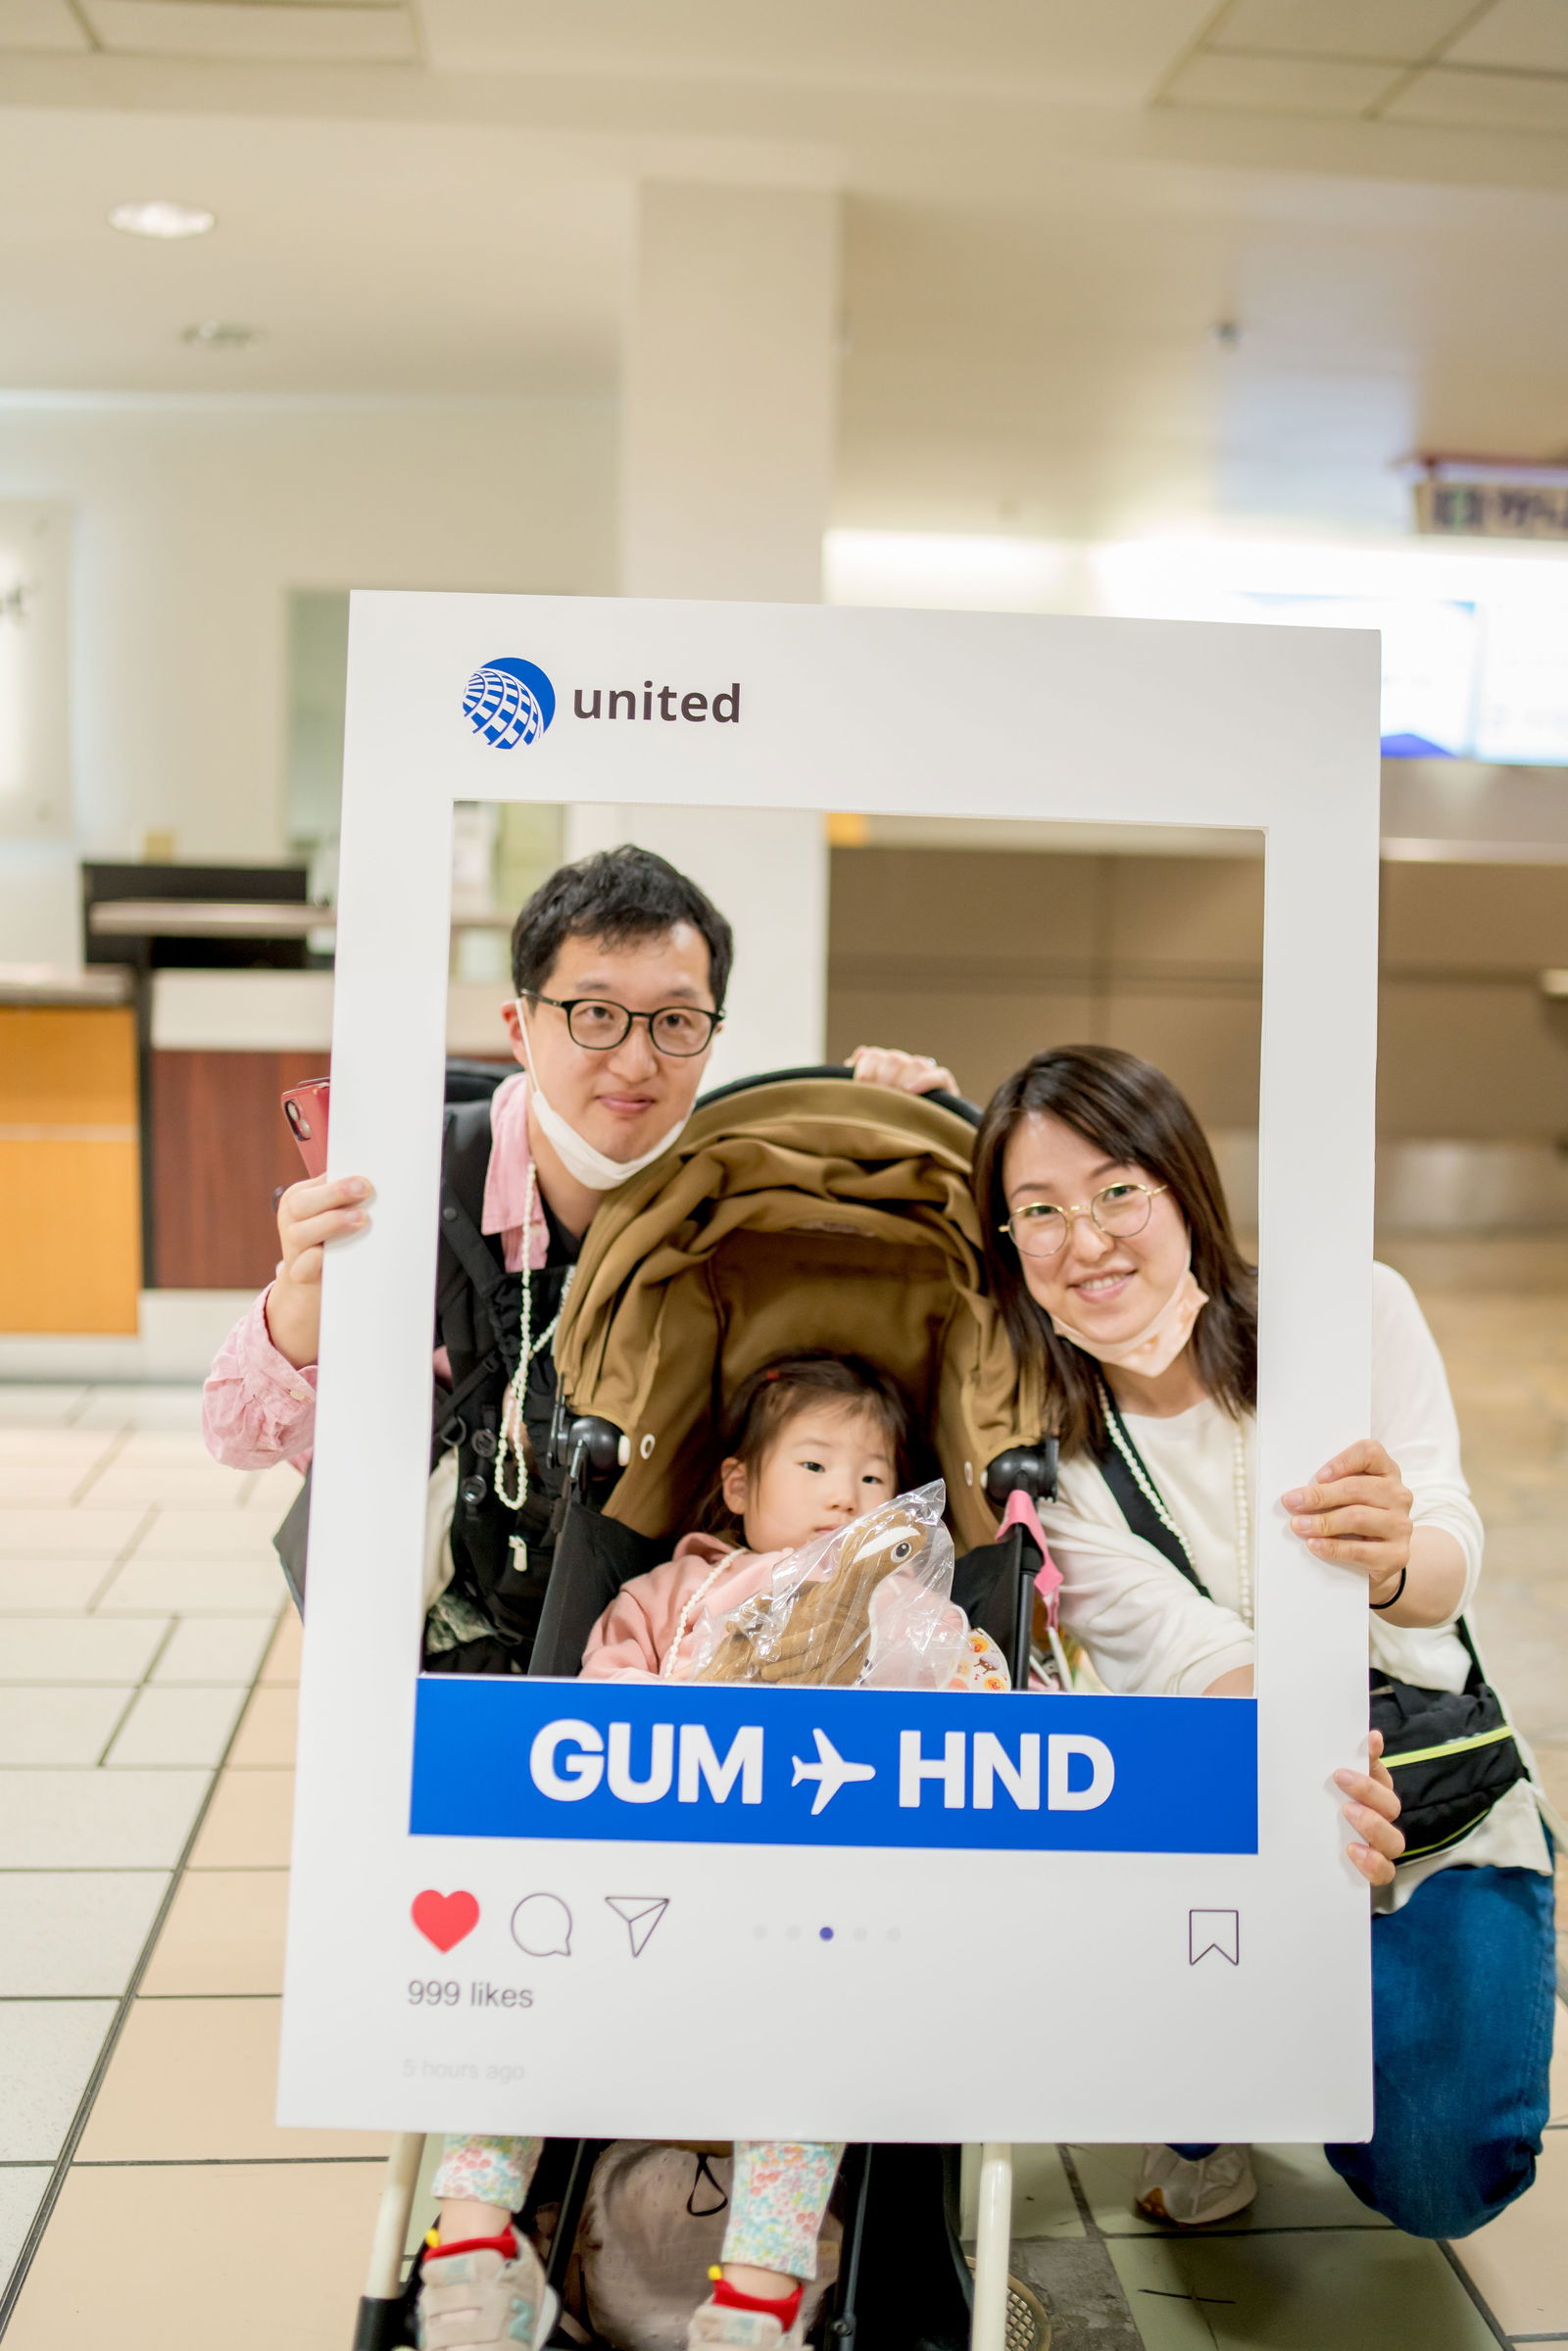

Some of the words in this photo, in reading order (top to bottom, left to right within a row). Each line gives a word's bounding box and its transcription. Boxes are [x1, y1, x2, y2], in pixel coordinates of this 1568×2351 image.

[573, 679, 742, 724] united
[529, 1719, 764, 1804] GUM
[899, 1730, 1116, 1812] HND
[408, 1980, 461, 2007] 999
[470, 1982, 534, 2009] likes
[402, 2059, 416, 2079] 5
[421, 2058, 479, 2080] hours
[485, 2064, 525, 2086] ago
